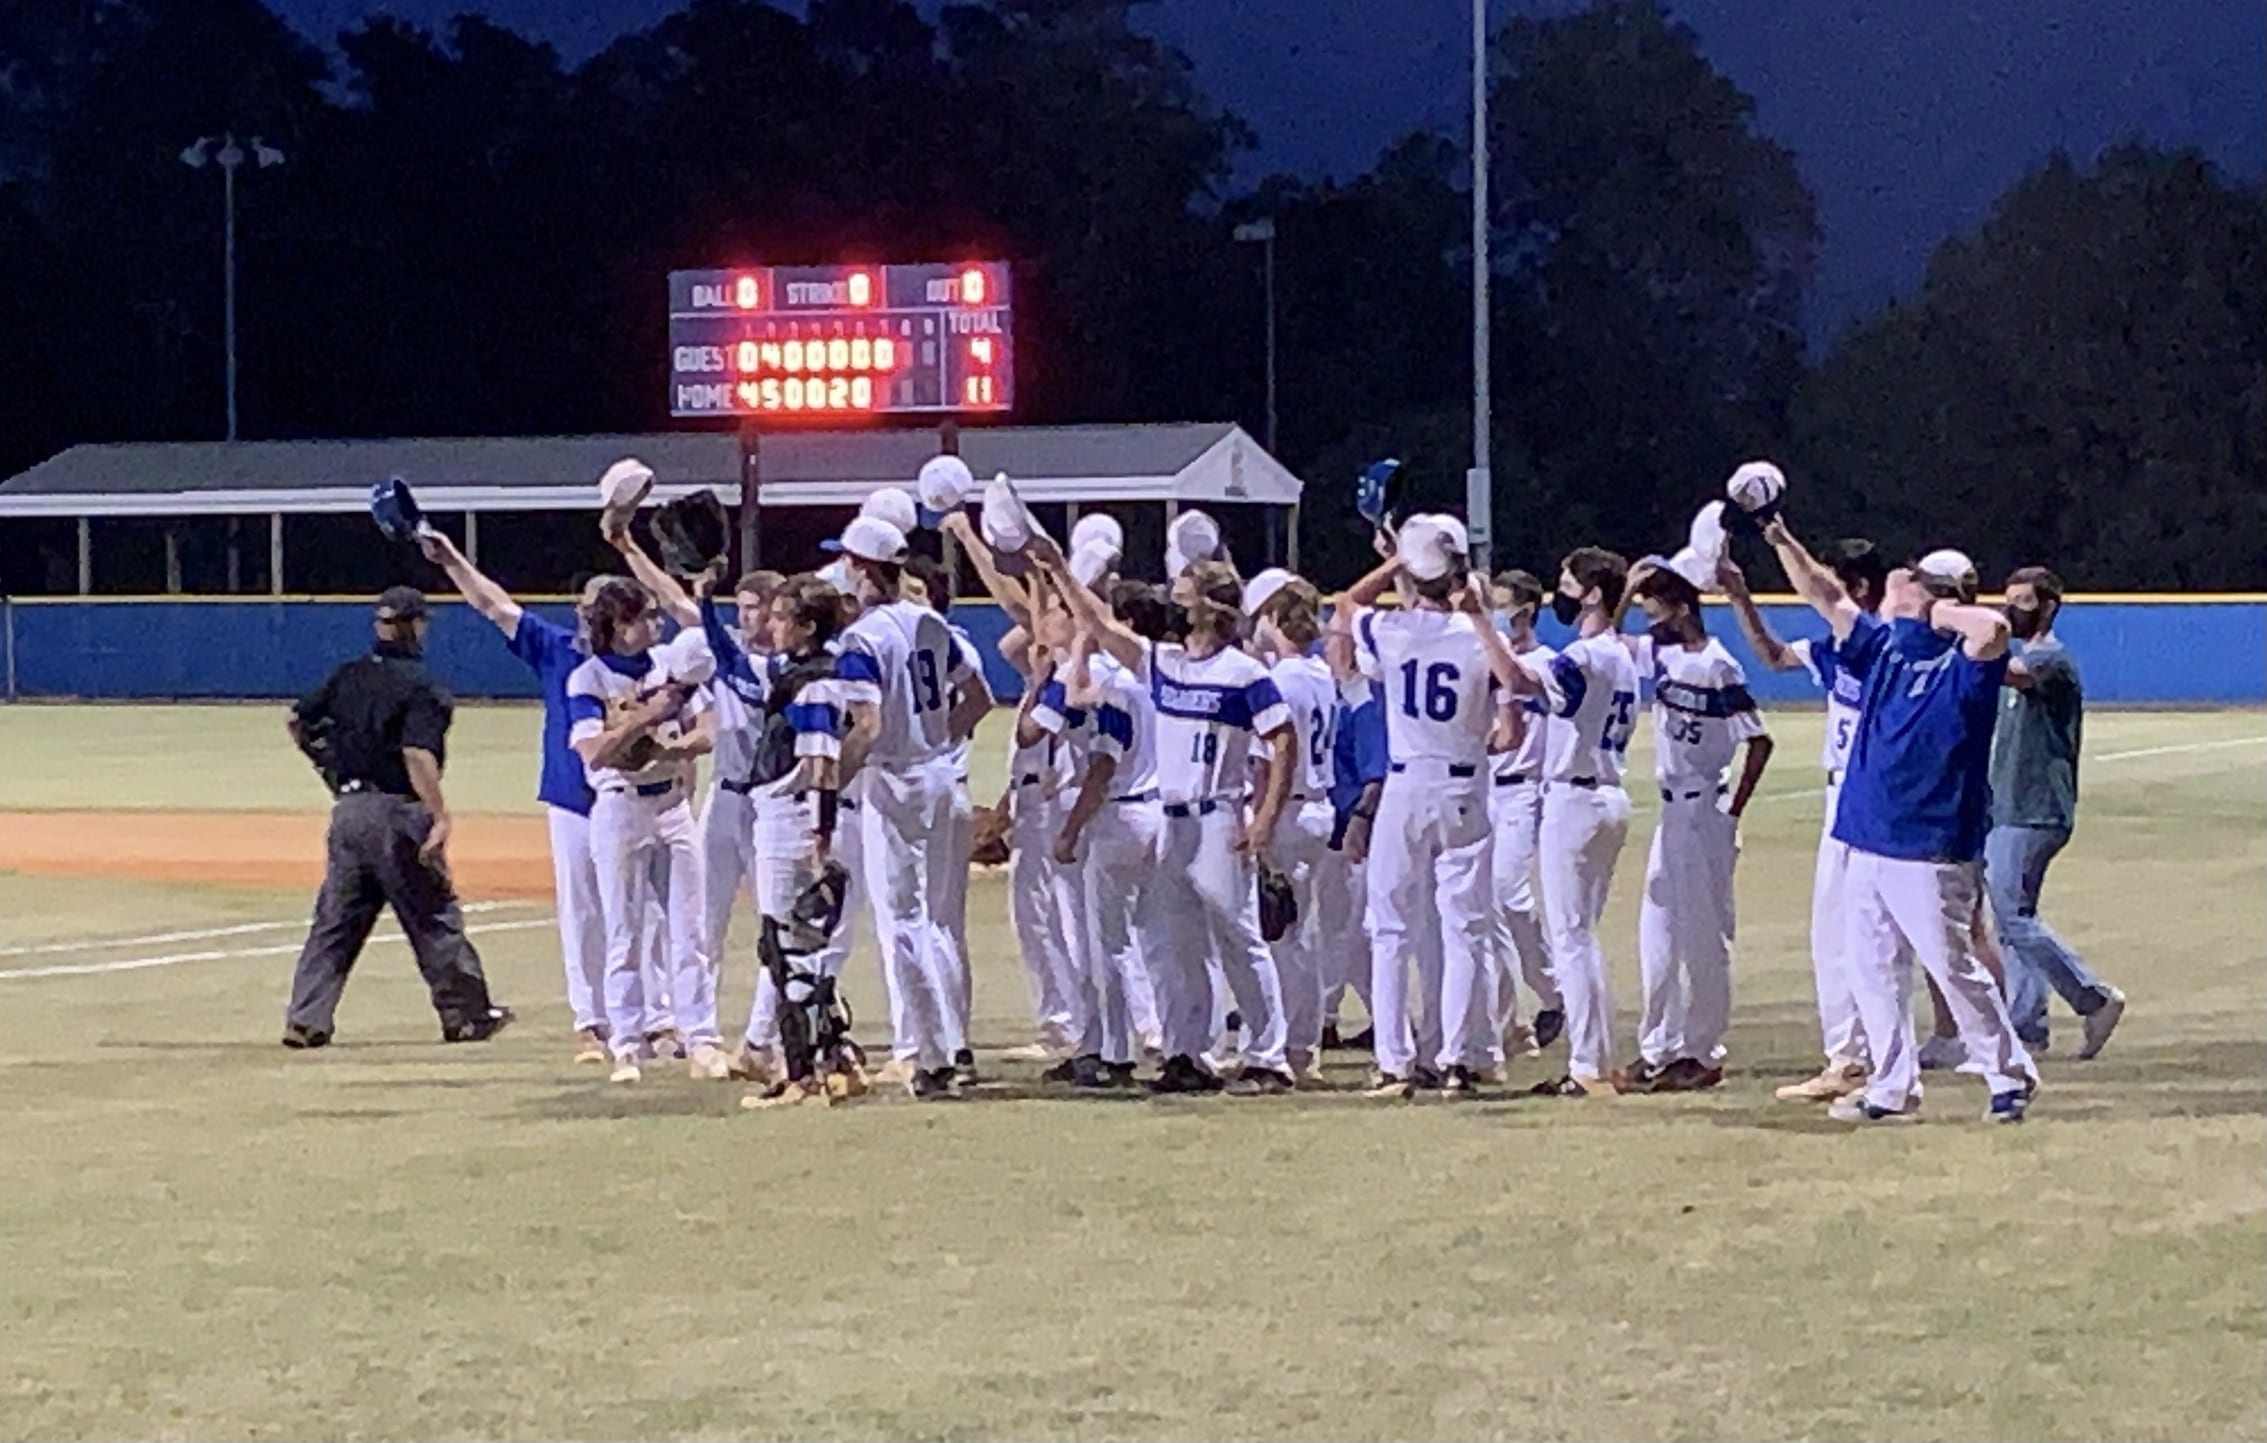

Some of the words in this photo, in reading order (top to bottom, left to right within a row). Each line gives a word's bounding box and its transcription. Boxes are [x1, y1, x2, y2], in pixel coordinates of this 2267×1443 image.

[950, 311, 1002, 334] TOTAL
[678, 382, 734, 409] HOME
[966, 375, 992, 404] 11
[1400, 657, 1461, 722] 16
[1190, 731, 1218, 765] 18
